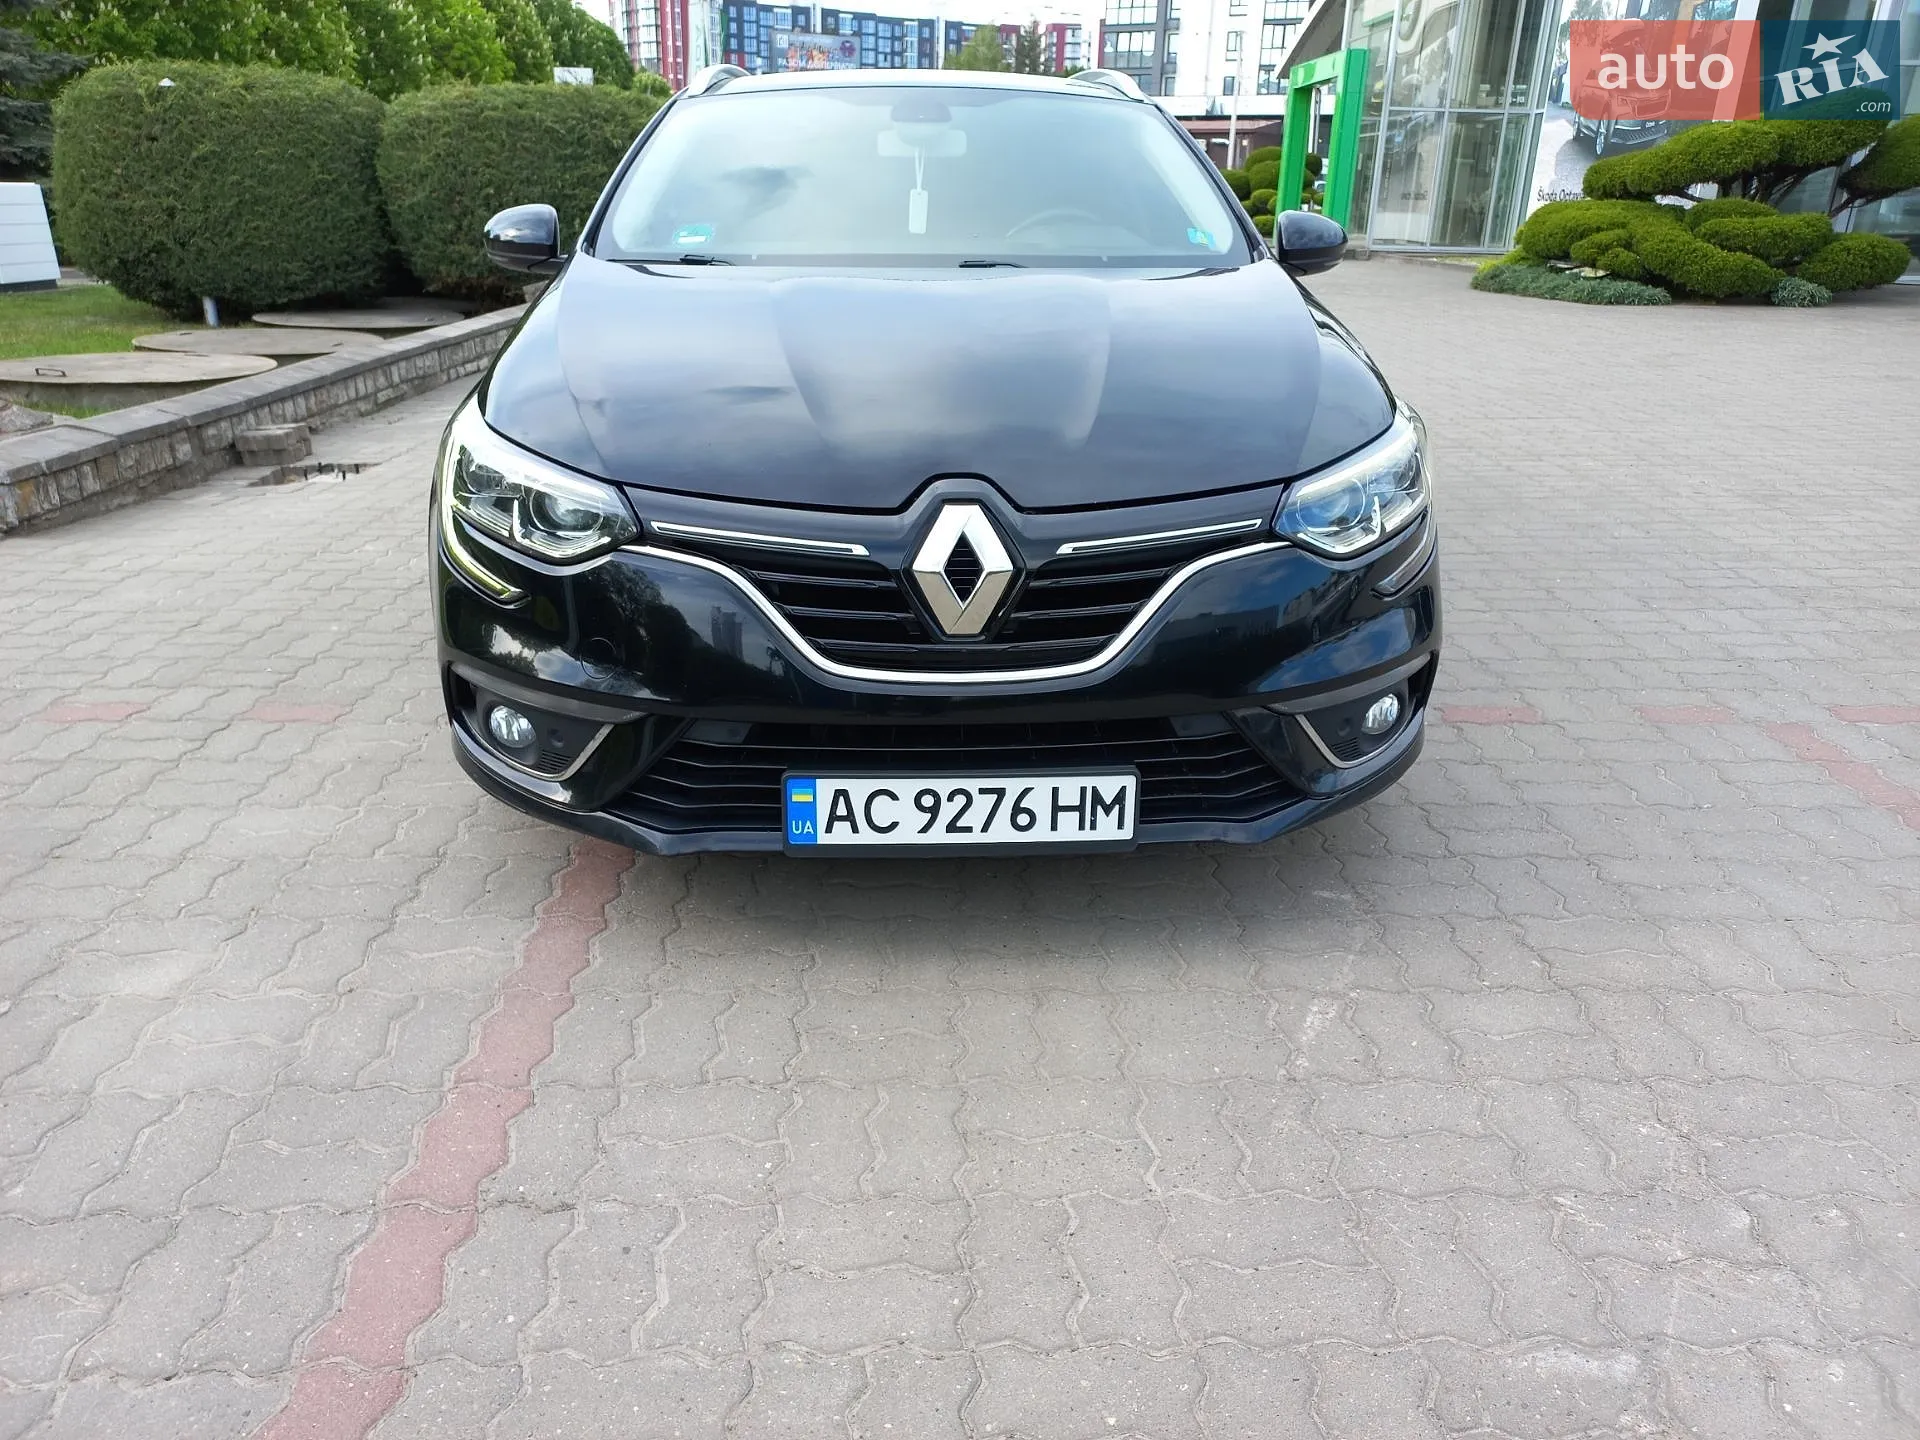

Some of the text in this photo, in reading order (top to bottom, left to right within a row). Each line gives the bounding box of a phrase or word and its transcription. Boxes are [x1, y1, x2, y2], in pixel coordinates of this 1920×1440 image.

[825, 785, 1128, 834] AC 9276 HM
[792, 820, 815, 835] UA
